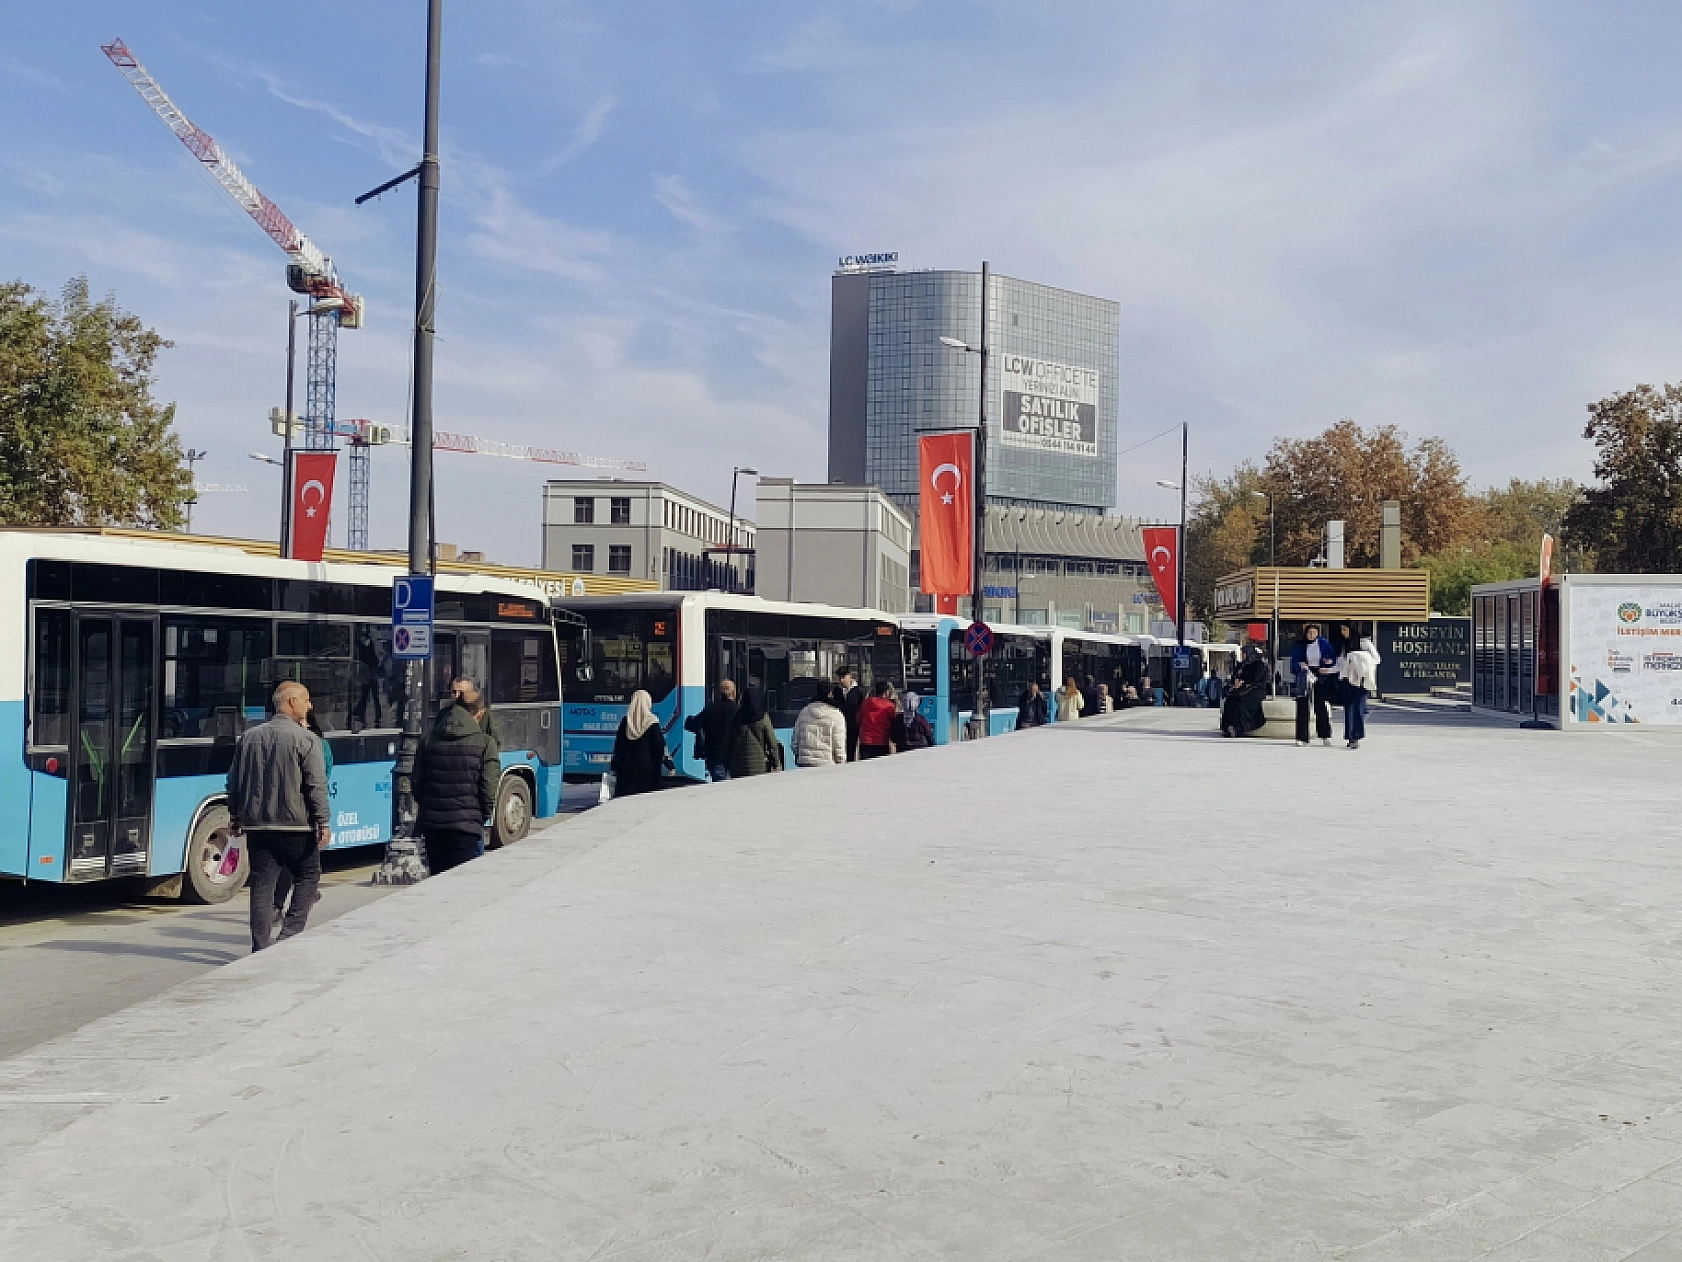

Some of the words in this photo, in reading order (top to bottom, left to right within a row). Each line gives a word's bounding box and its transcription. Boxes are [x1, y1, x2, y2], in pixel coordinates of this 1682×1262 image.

[838, 256, 853, 266] LC
[1004, 356, 1034, 376] LCW
[1020, 395, 1080, 421] SATILIK
[395, 580, 412, 610] D
[1398, 624, 1464, 638] HÜSEYİN
[337, 811, 359, 826] ÖZEL
